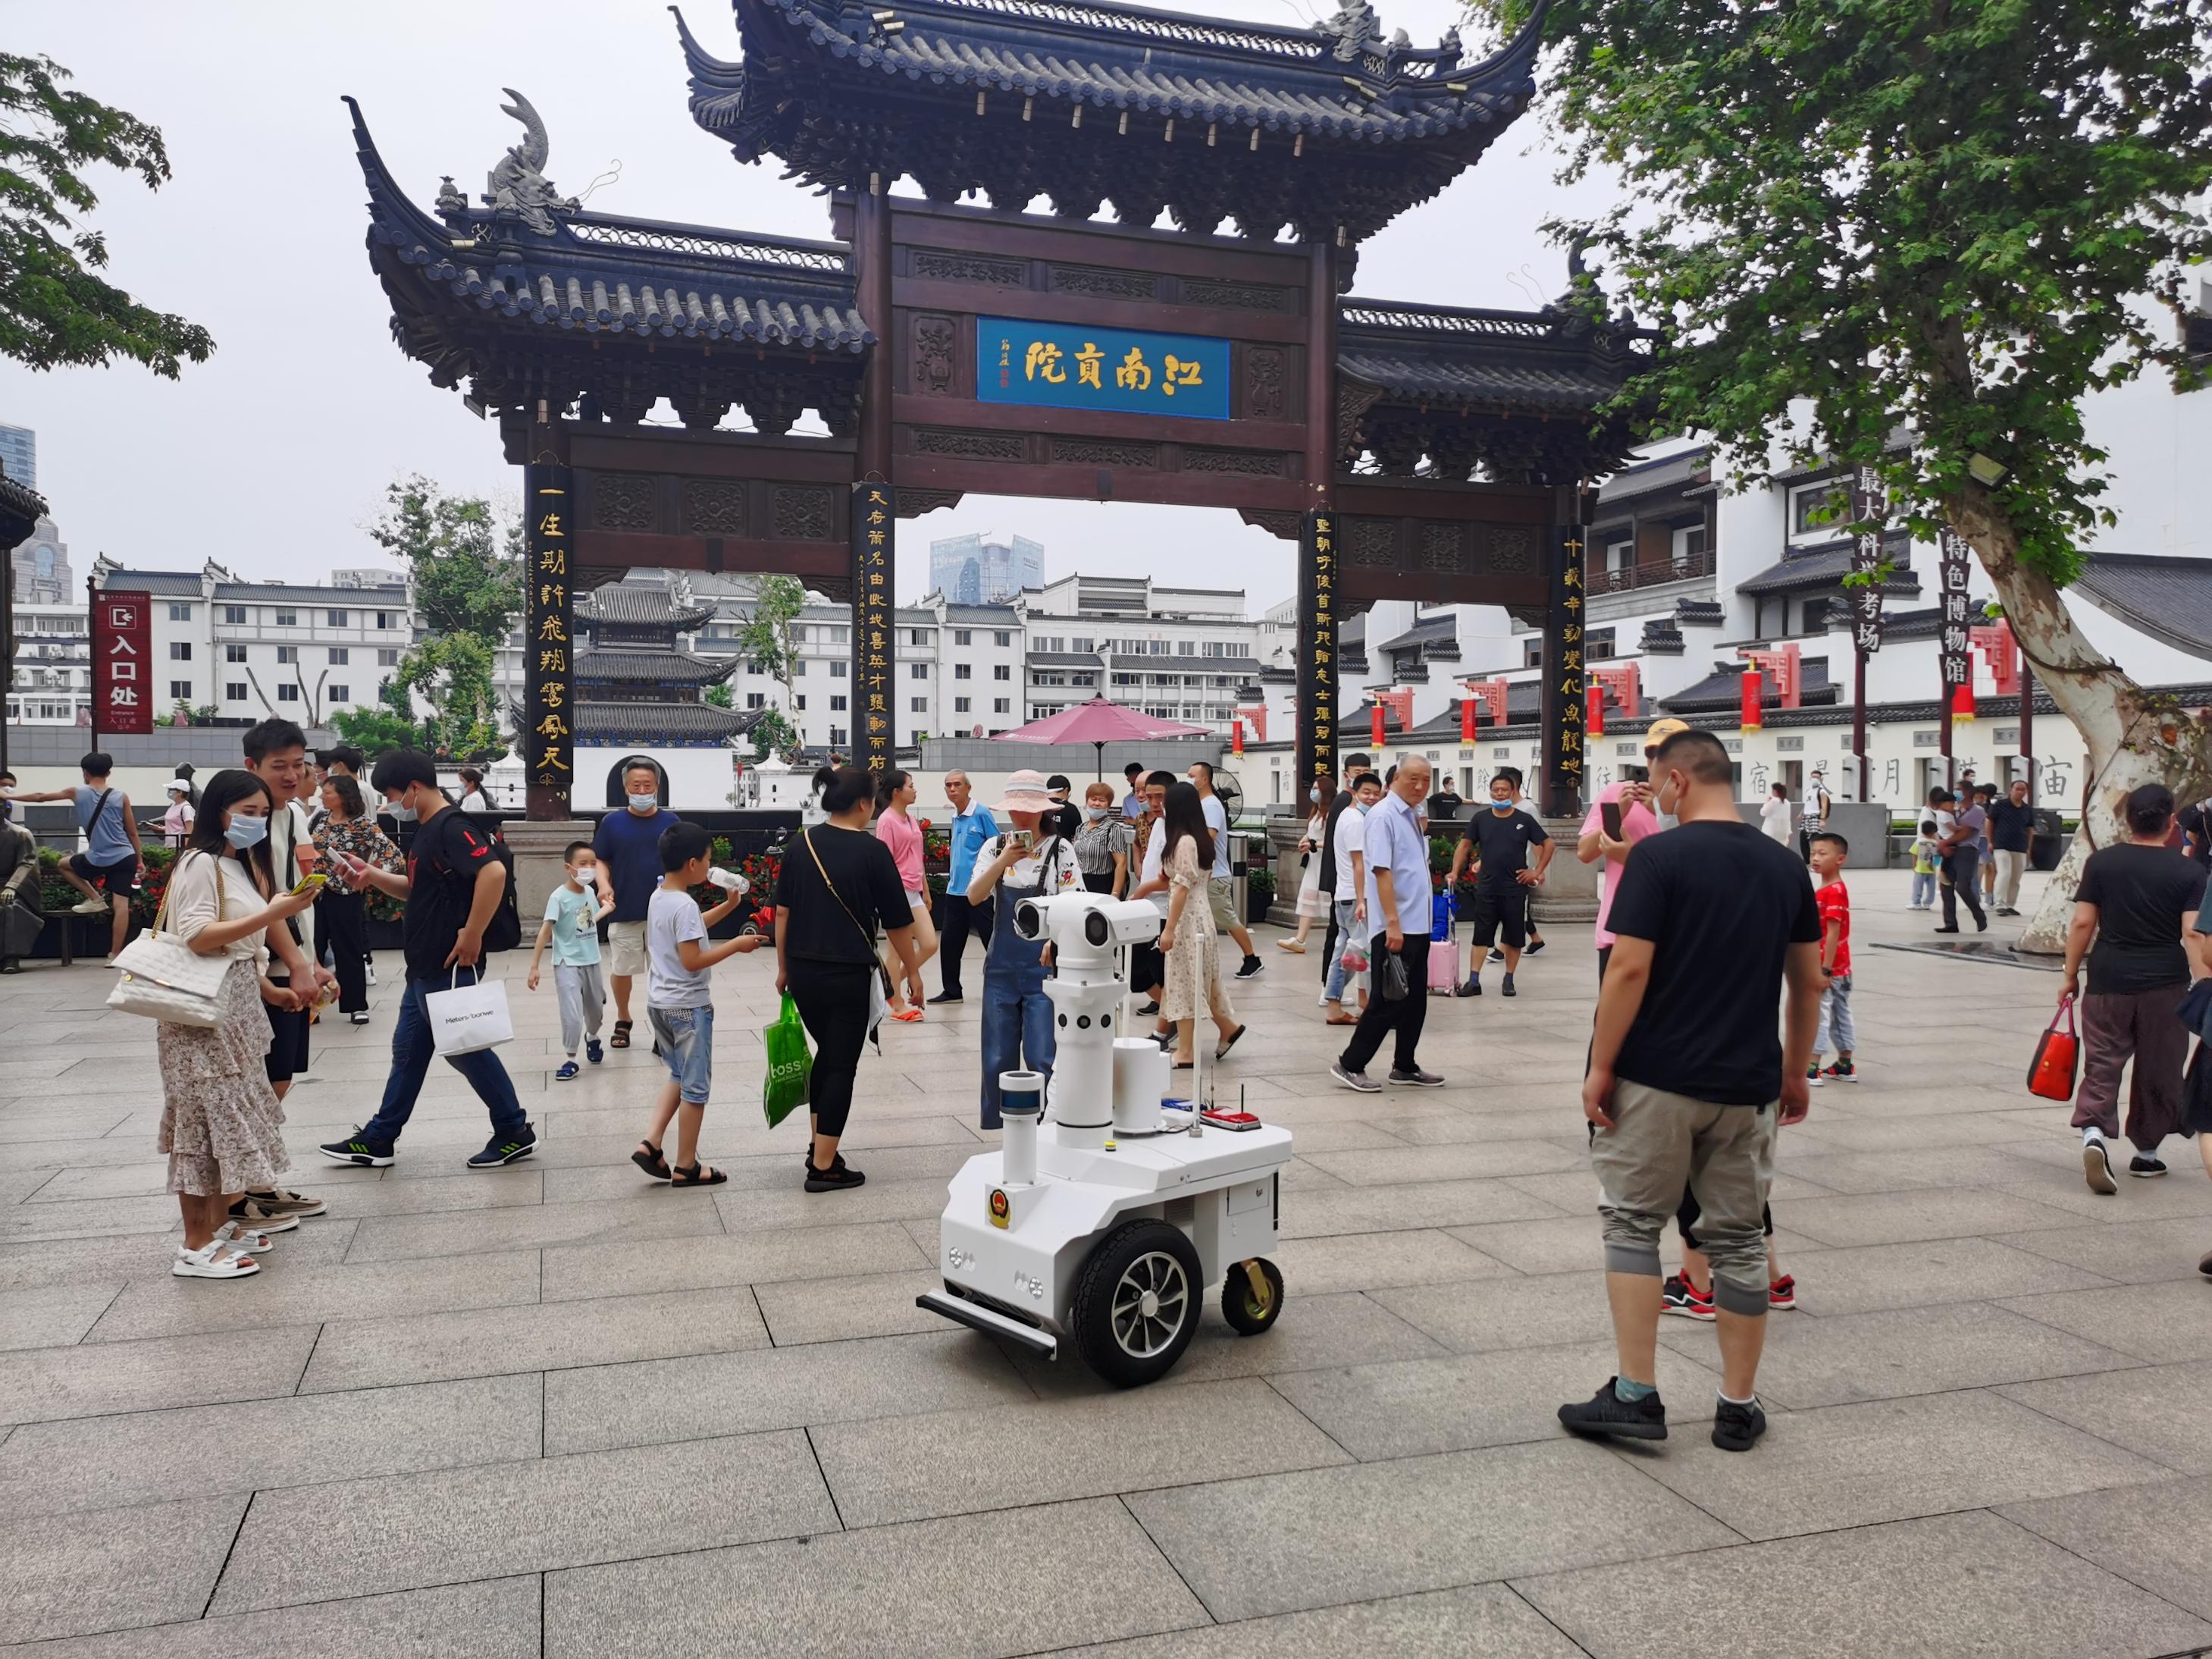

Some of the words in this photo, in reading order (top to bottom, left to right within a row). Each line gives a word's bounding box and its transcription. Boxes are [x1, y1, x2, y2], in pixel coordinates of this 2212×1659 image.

[1025, 341, 1203, 396] 江南貢院
[1944, 534, 1969, 683] 特色博物馆
[109, 635, 139, 707] 入口处
